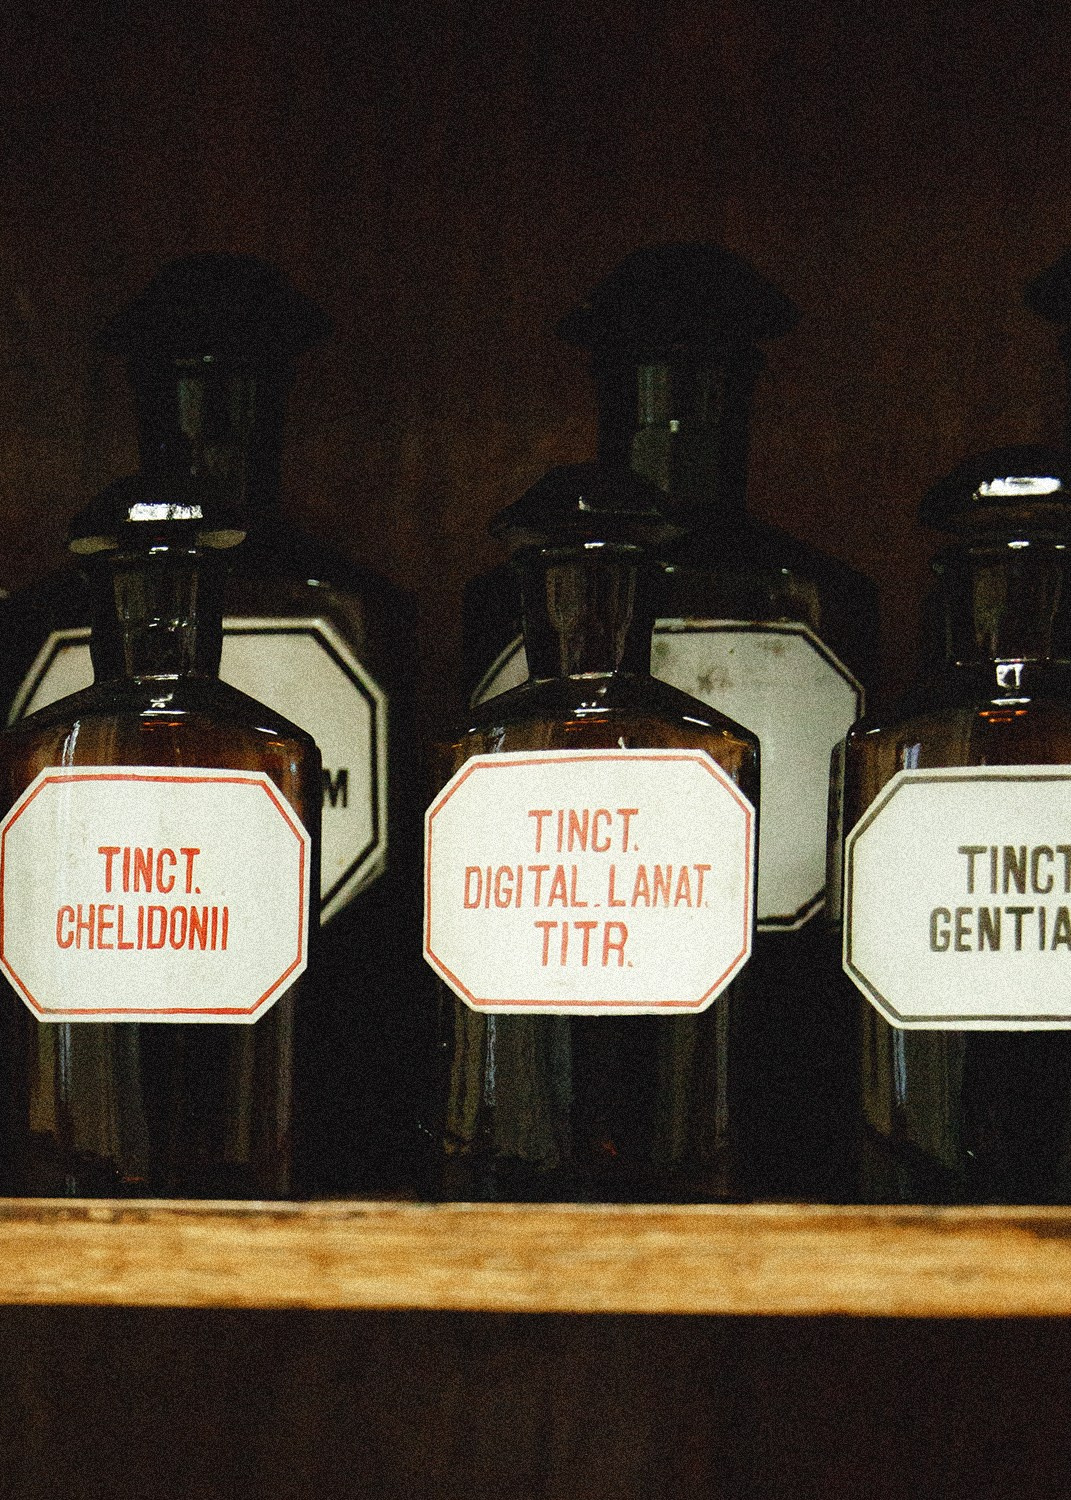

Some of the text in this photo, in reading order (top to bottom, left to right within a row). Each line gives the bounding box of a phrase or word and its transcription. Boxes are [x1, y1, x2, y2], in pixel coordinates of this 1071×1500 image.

[528, 807, 640, 853] TINCT.
[97, 846, 202, 894] TINCT.
[55, 903, 230, 951] CHELIDONII
[534, 920, 635, 968] TITR.
[928, 905, 1071, 953] GENTIA
